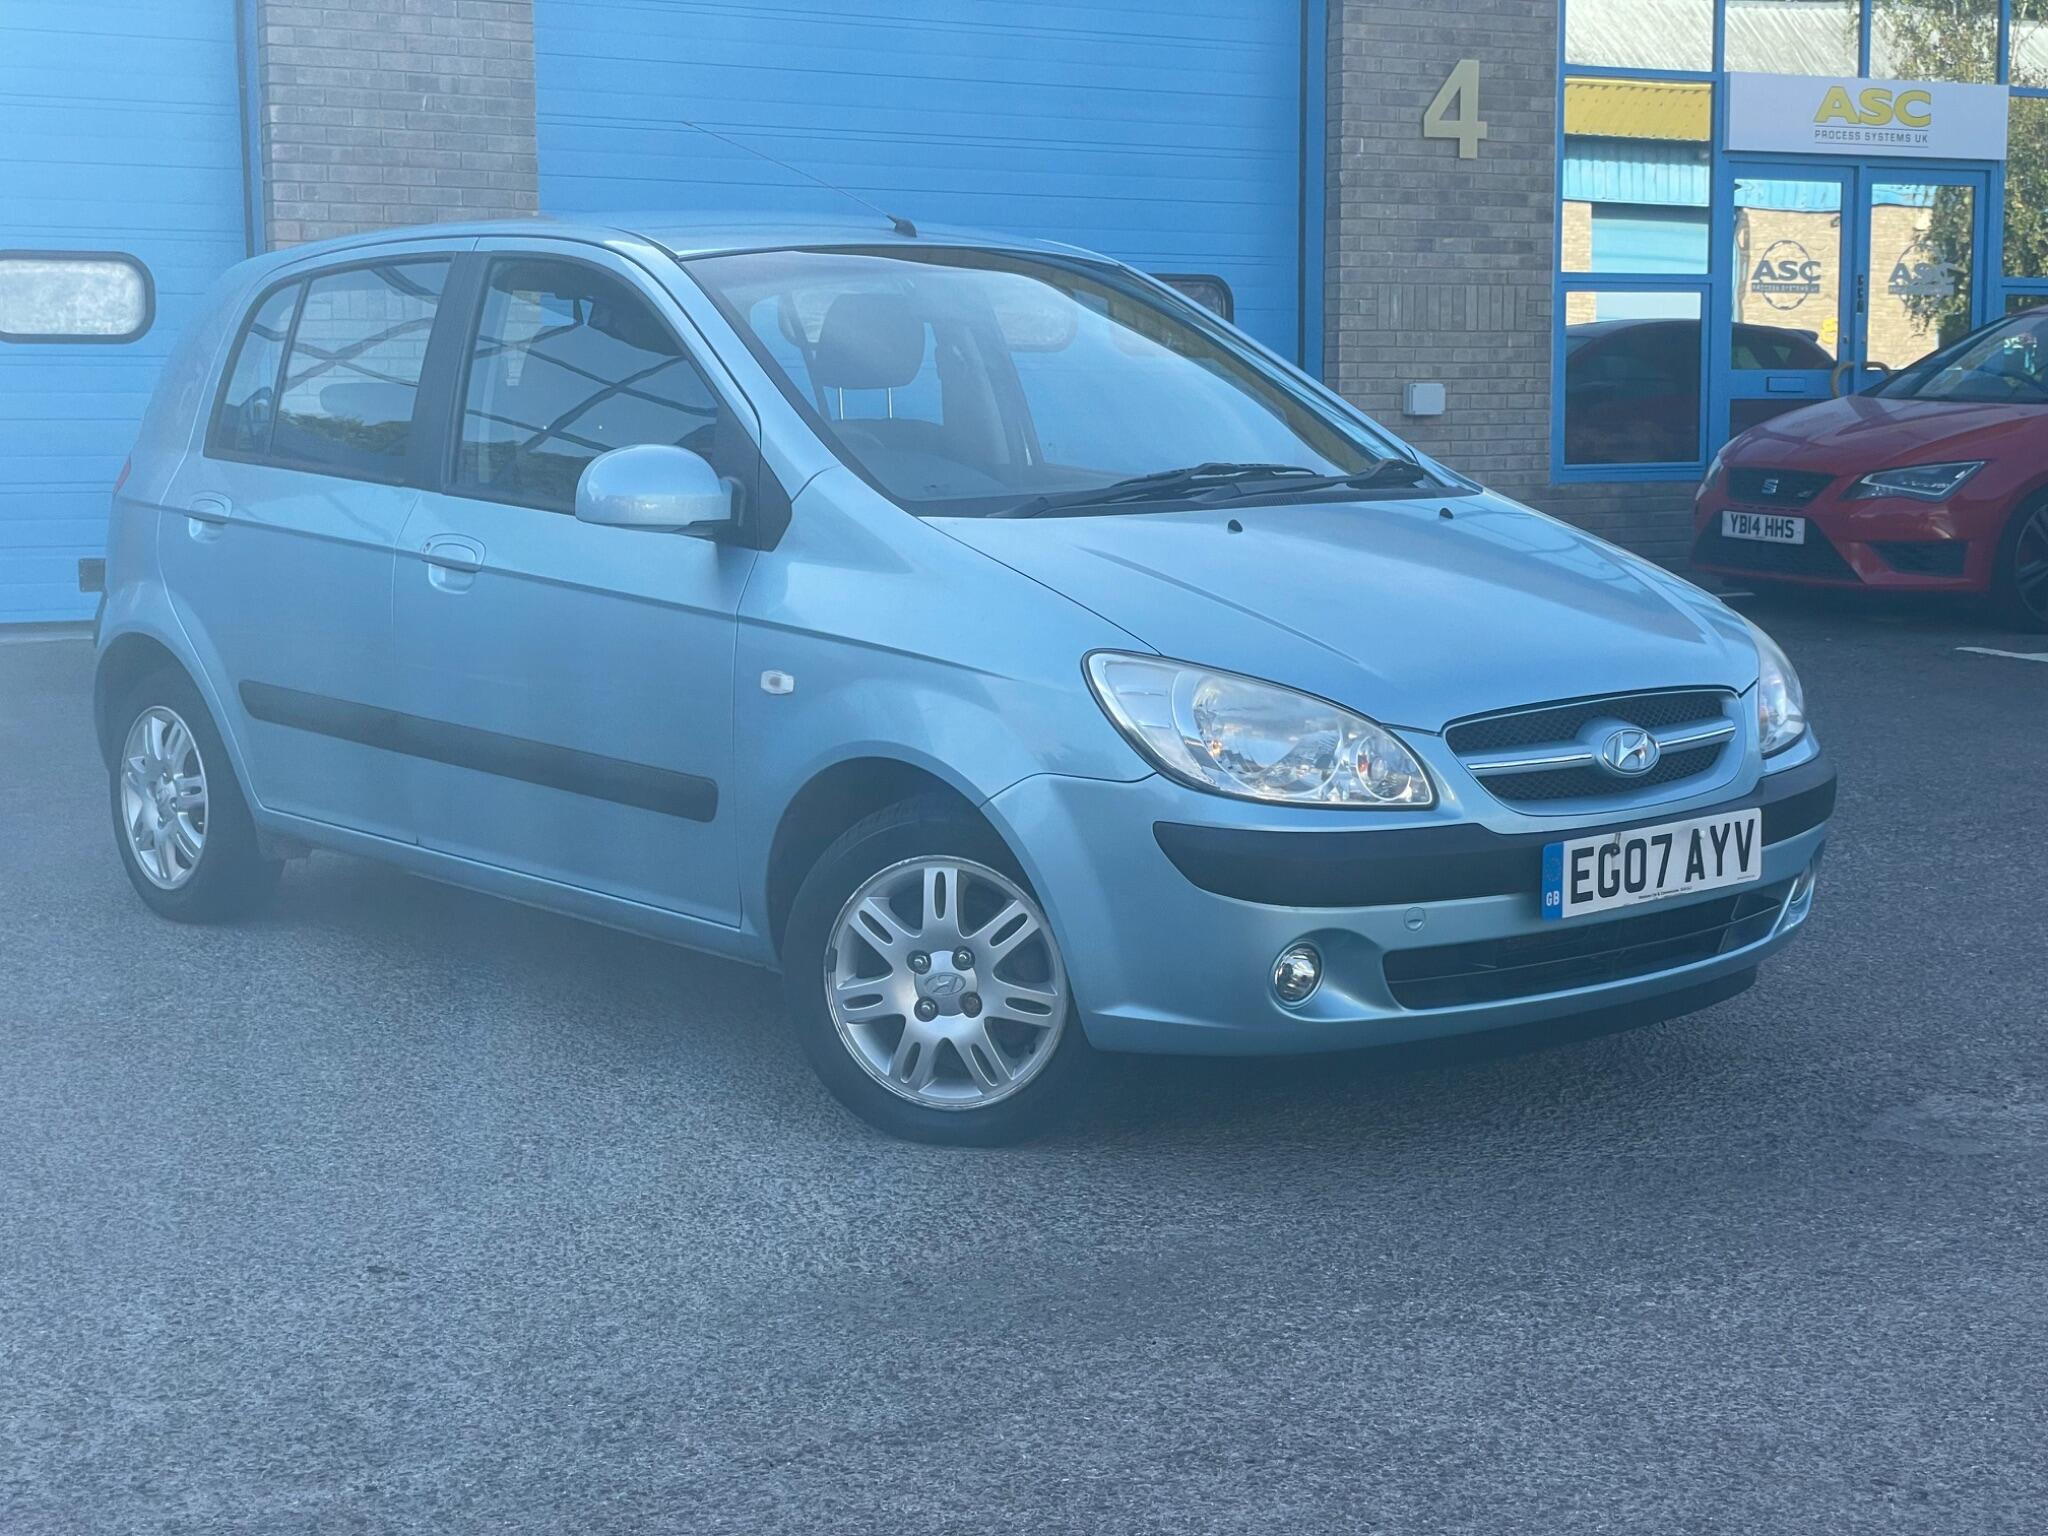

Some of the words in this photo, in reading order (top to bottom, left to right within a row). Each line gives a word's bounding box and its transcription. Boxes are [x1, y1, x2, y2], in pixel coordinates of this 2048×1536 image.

[1423, 59, 1487, 159] 4
[1813, 86, 1931, 127] ASC
[1814, 130, 1860, 141] PROCESS
[1864, 132, 1911, 143] SYSTEMS
[1914, 134, 1928, 143] UK
[1751, 260, 1821, 281] ASC
[1731, 514, 1760, 535] YB14
[1764, 517, 1794, 538] HHS
[1571, 833, 1673, 905] EG07
[1685, 818, 1755, 883] AYV
[1546, 890, 1560, 906] GB
